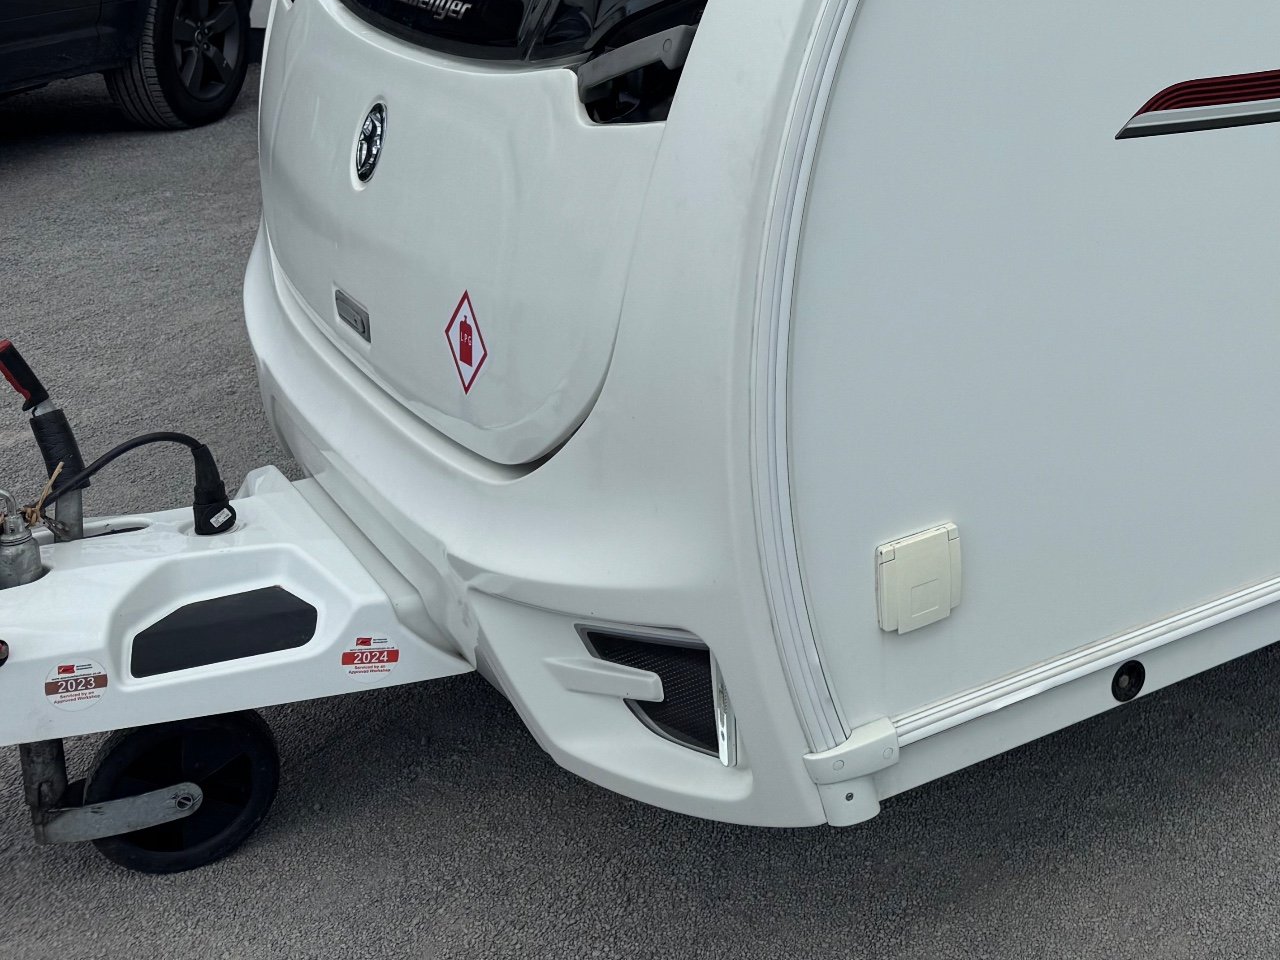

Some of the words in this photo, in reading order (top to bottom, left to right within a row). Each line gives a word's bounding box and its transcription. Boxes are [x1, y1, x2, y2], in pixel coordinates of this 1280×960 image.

[460, 331, 472, 346] LPG
[353, 651, 388, 663] 2024
[58, 677, 96, 692] 2023
